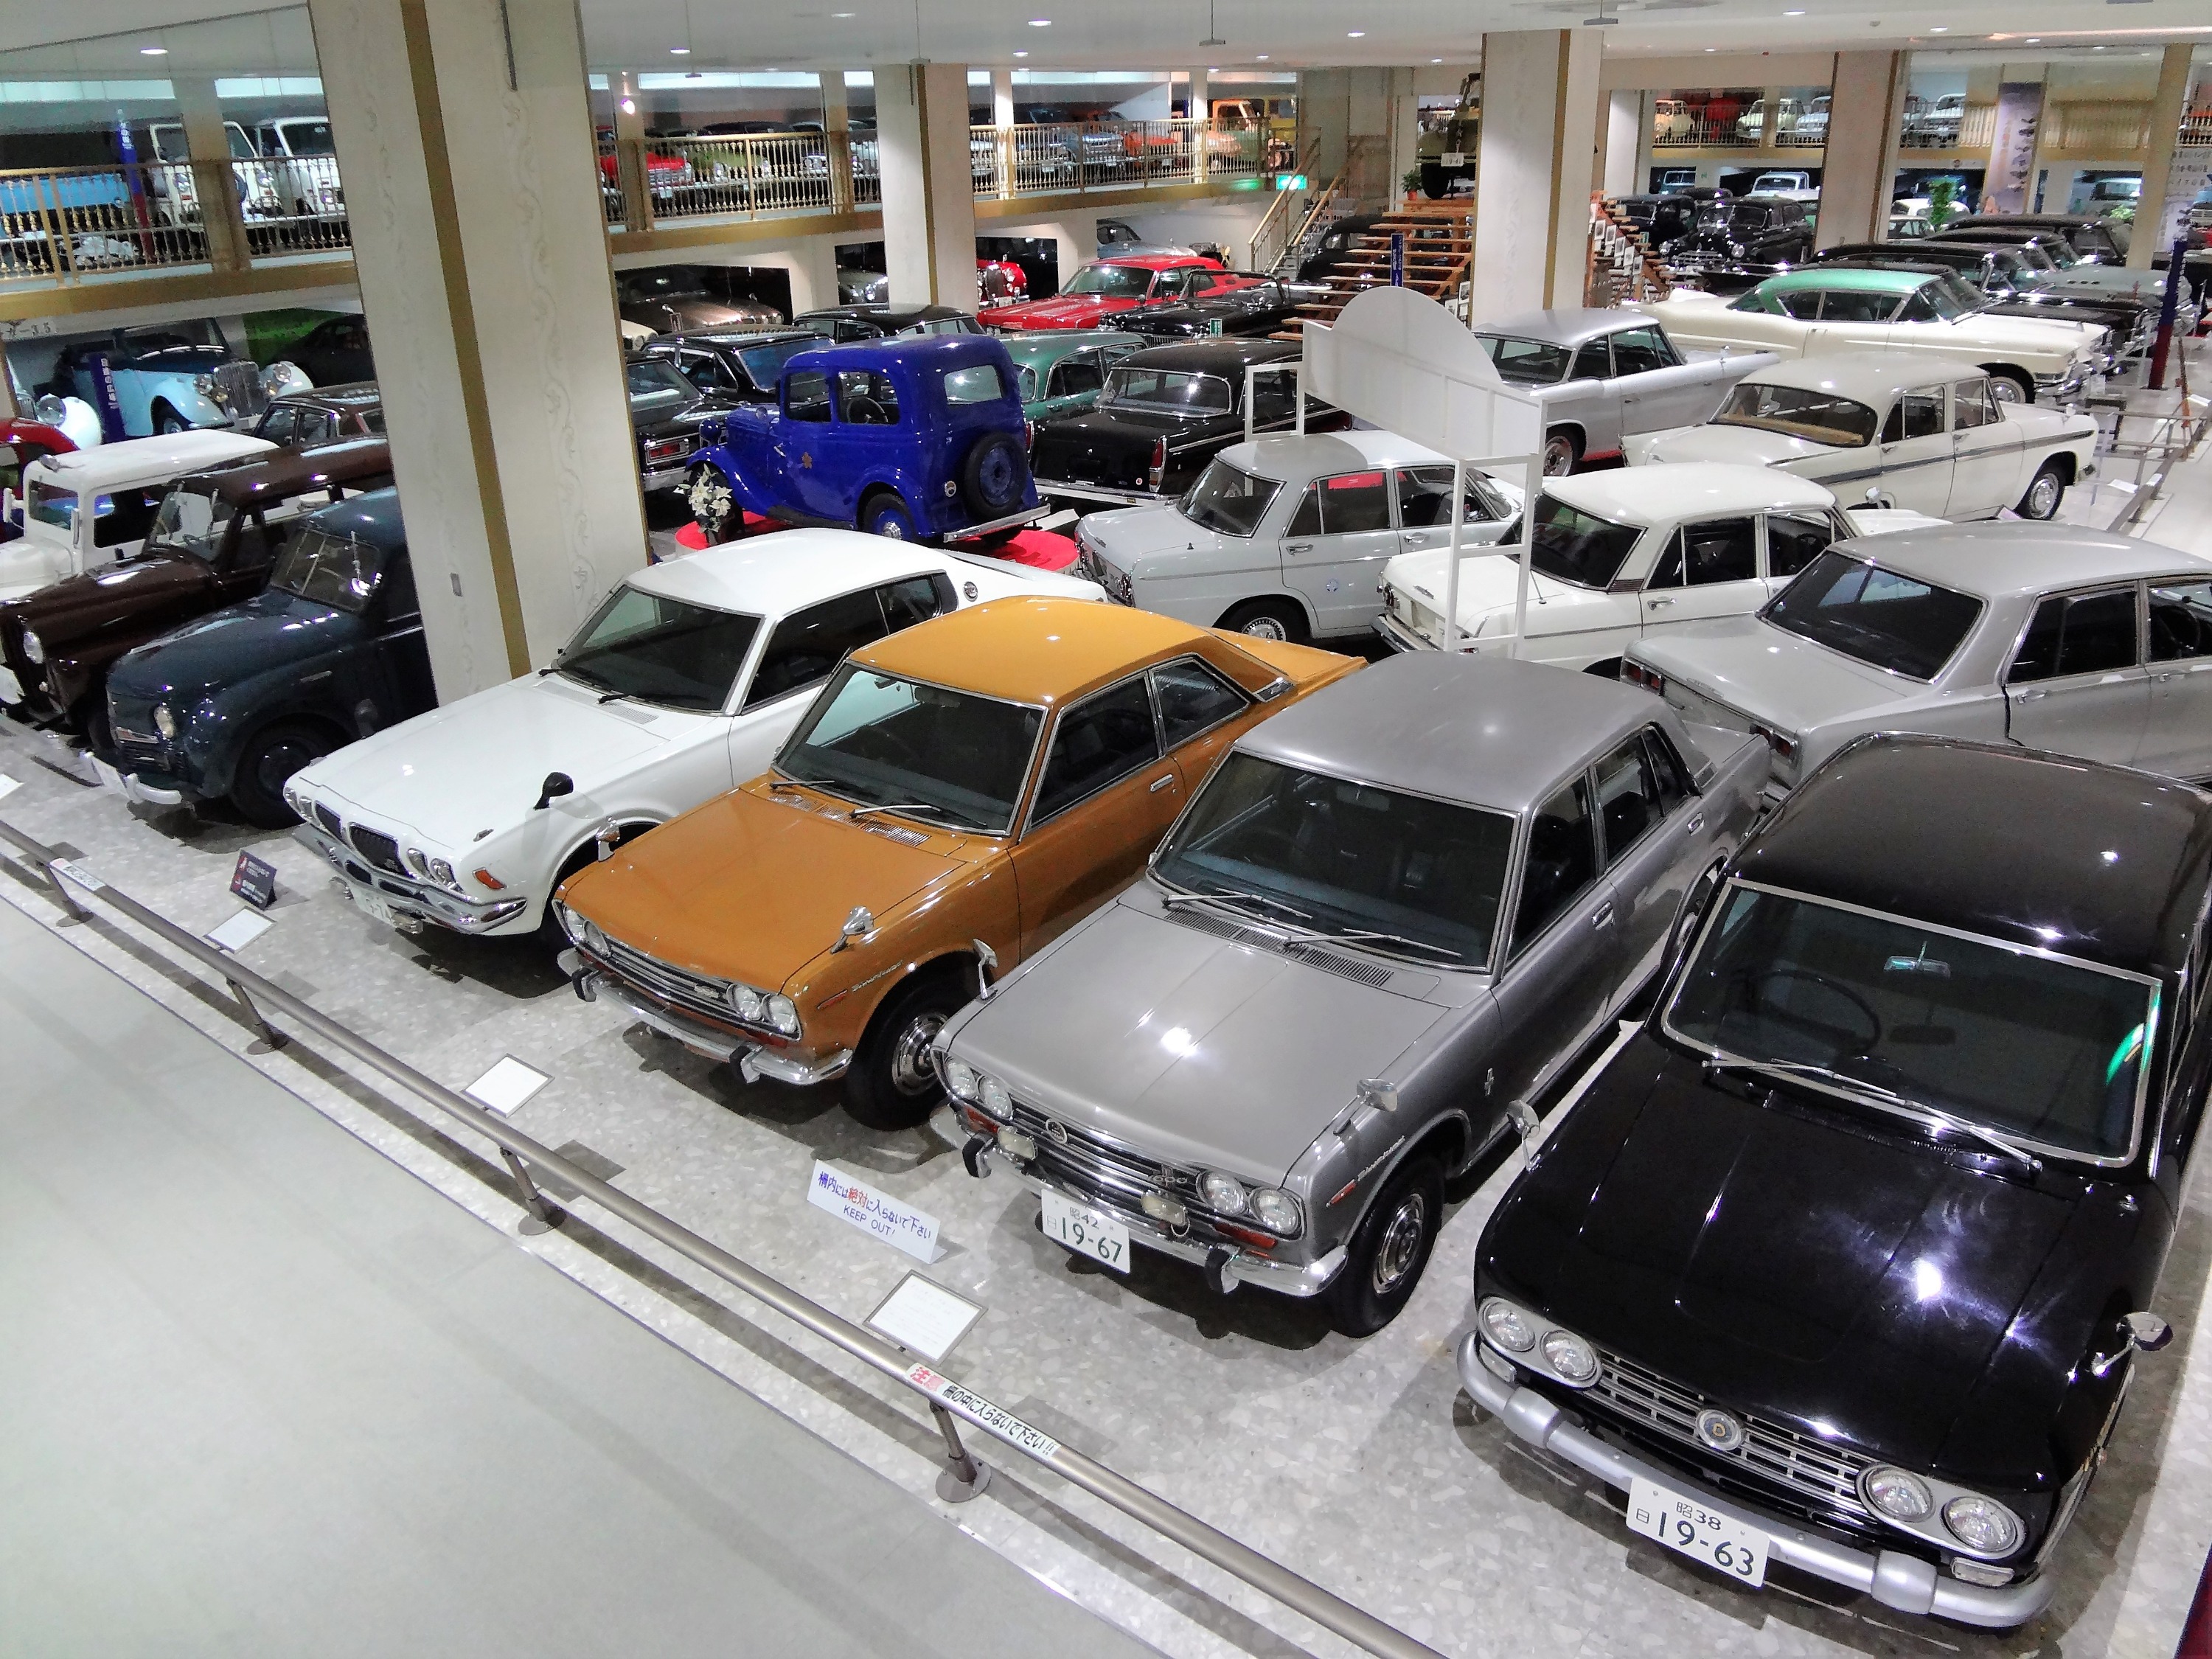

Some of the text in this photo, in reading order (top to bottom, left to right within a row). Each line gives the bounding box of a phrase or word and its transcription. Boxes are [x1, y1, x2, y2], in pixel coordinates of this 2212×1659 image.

[843, 1204, 896, 1238] KEEP OUT!
[1069, 1206, 1100, 1230] 昭42
[1062, 1216, 1123, 1263] 19-67
[1635, 1508, 1650, 1524] 日
[1676, 1501, 1722, 1531] 昭38
[1658, 1511, 1754, 1576] 19-63
